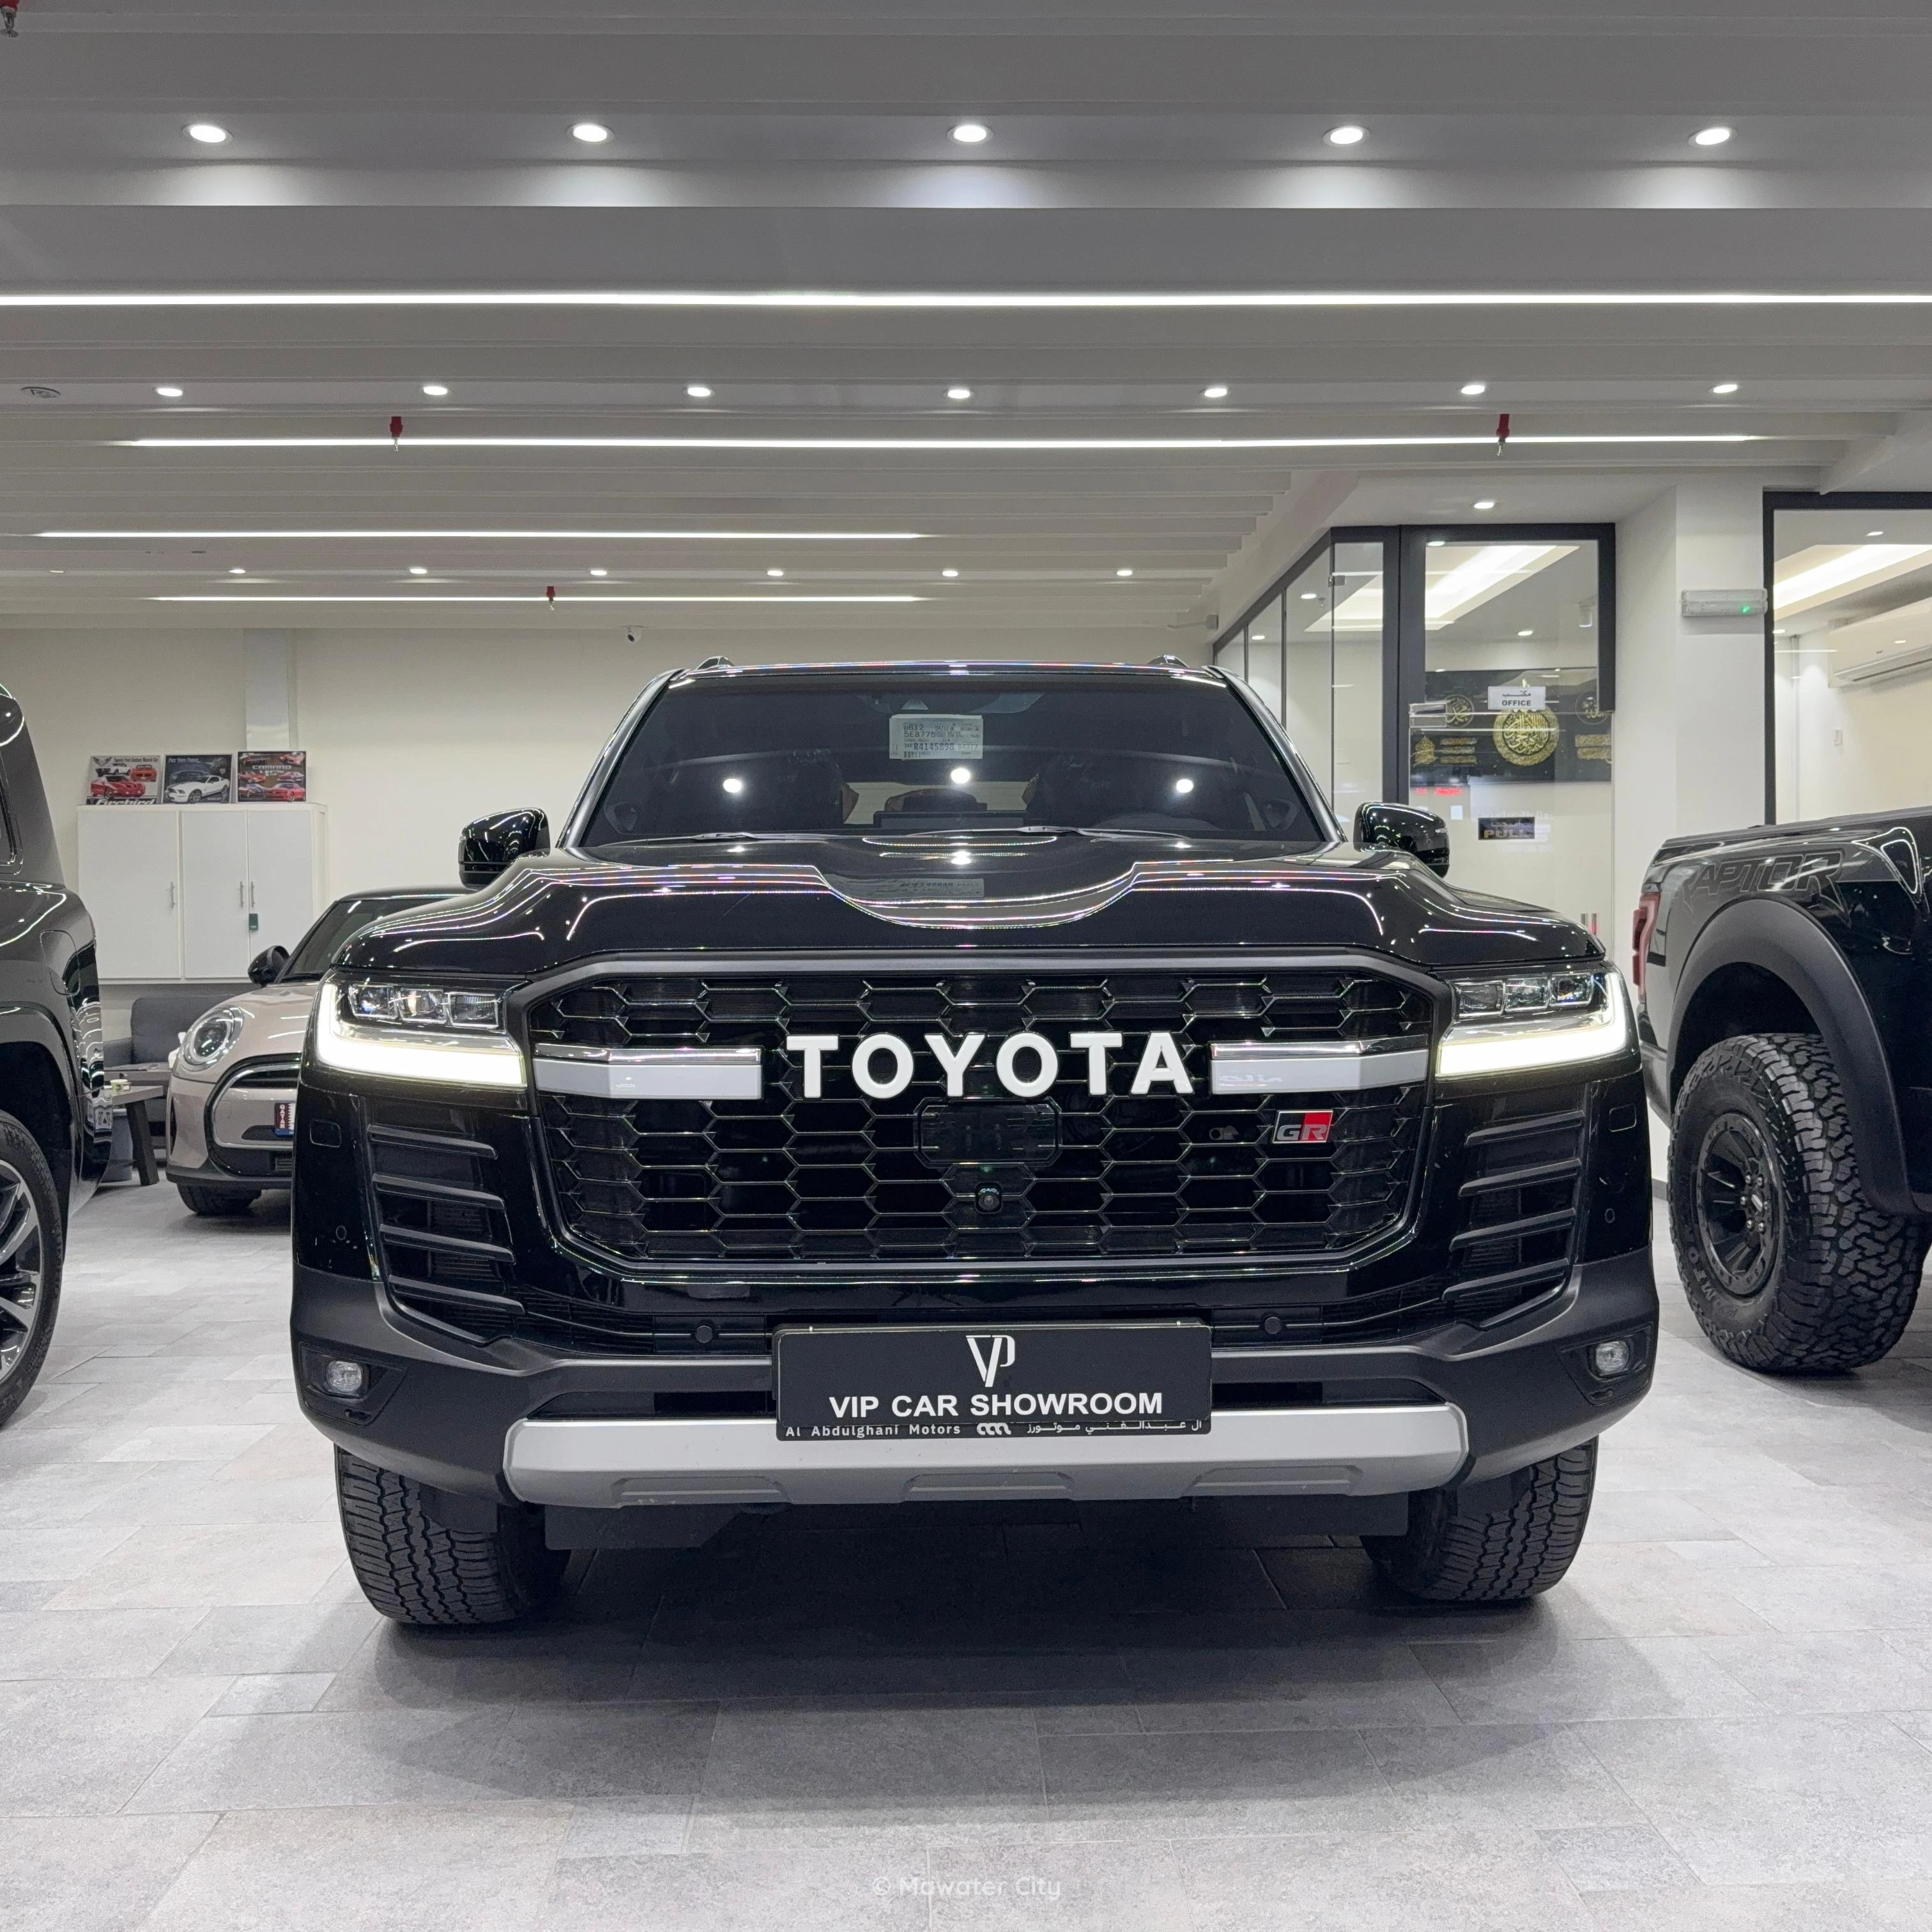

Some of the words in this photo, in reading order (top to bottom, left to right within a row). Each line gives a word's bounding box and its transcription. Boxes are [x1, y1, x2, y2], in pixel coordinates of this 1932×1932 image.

[914, 742, 954, 751] R4145898
[786, 1031, 1194, 1099] TOYOTA
[1276, 1124, 1327, 1140] GR
[829, 1396, 879, 1418] VIP
[891, 1395, 959, 1417] CAR
[970, 1392, 1162, 1416] SHOWROOM
[785, 1426, 801, 1437] Al
[811, 1424, 898, 1438] Abdulghani
[909, 1423, 962, 1435] Motors
